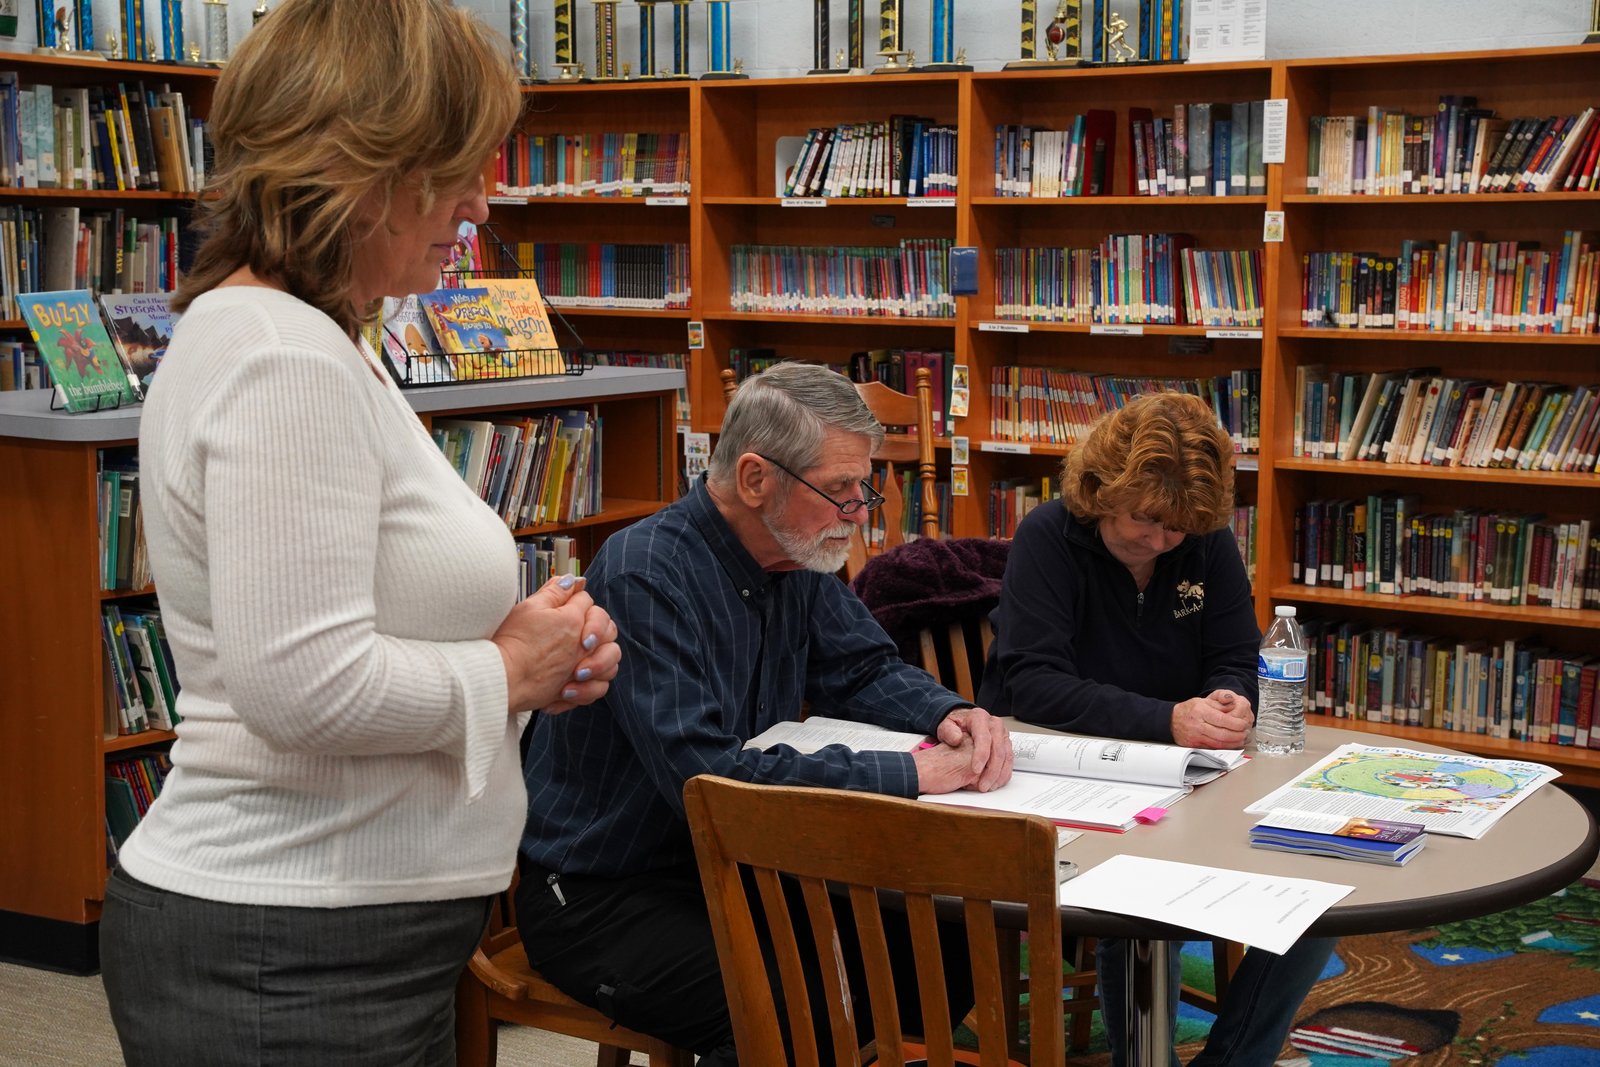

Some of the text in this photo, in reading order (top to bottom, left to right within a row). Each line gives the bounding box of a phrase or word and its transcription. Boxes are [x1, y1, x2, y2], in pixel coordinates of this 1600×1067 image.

[115, 248, 124, 274] MAYA
[132, 297, 147, 305] Can
[450, 293, 478, 304] When a
[494, 285, 517, 301] Your
[32, 301, 92, 329] BUZZY
[114, 304, 168, 315] STEGOSAU
[453, 303, 494, 321] DRAGON
[503, 300, 542, 319] Typical
[68, 378, 125, 397] the bumblebee
